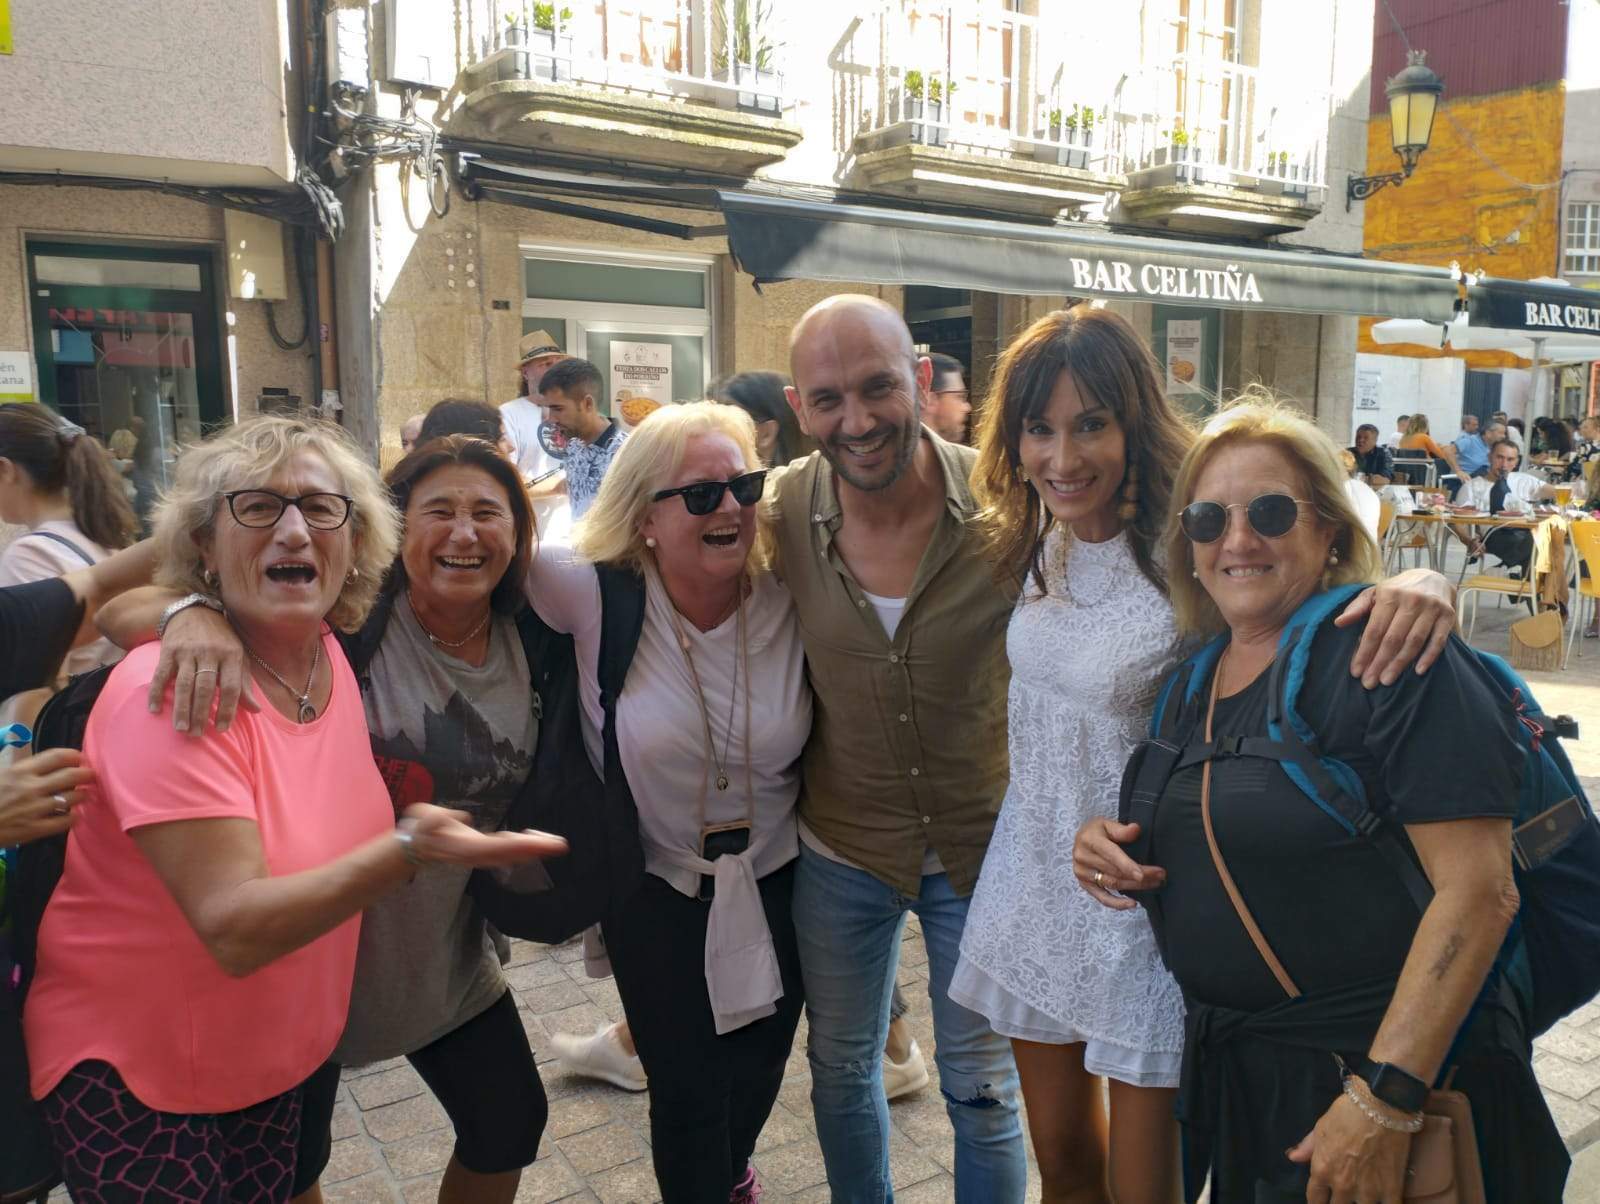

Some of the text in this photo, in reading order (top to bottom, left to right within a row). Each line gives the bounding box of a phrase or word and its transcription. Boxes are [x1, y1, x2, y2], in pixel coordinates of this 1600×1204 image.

[1070, 258, 1264, 303] BAR CELTIÑA
[1525, 302, 1565, 327] BAR
